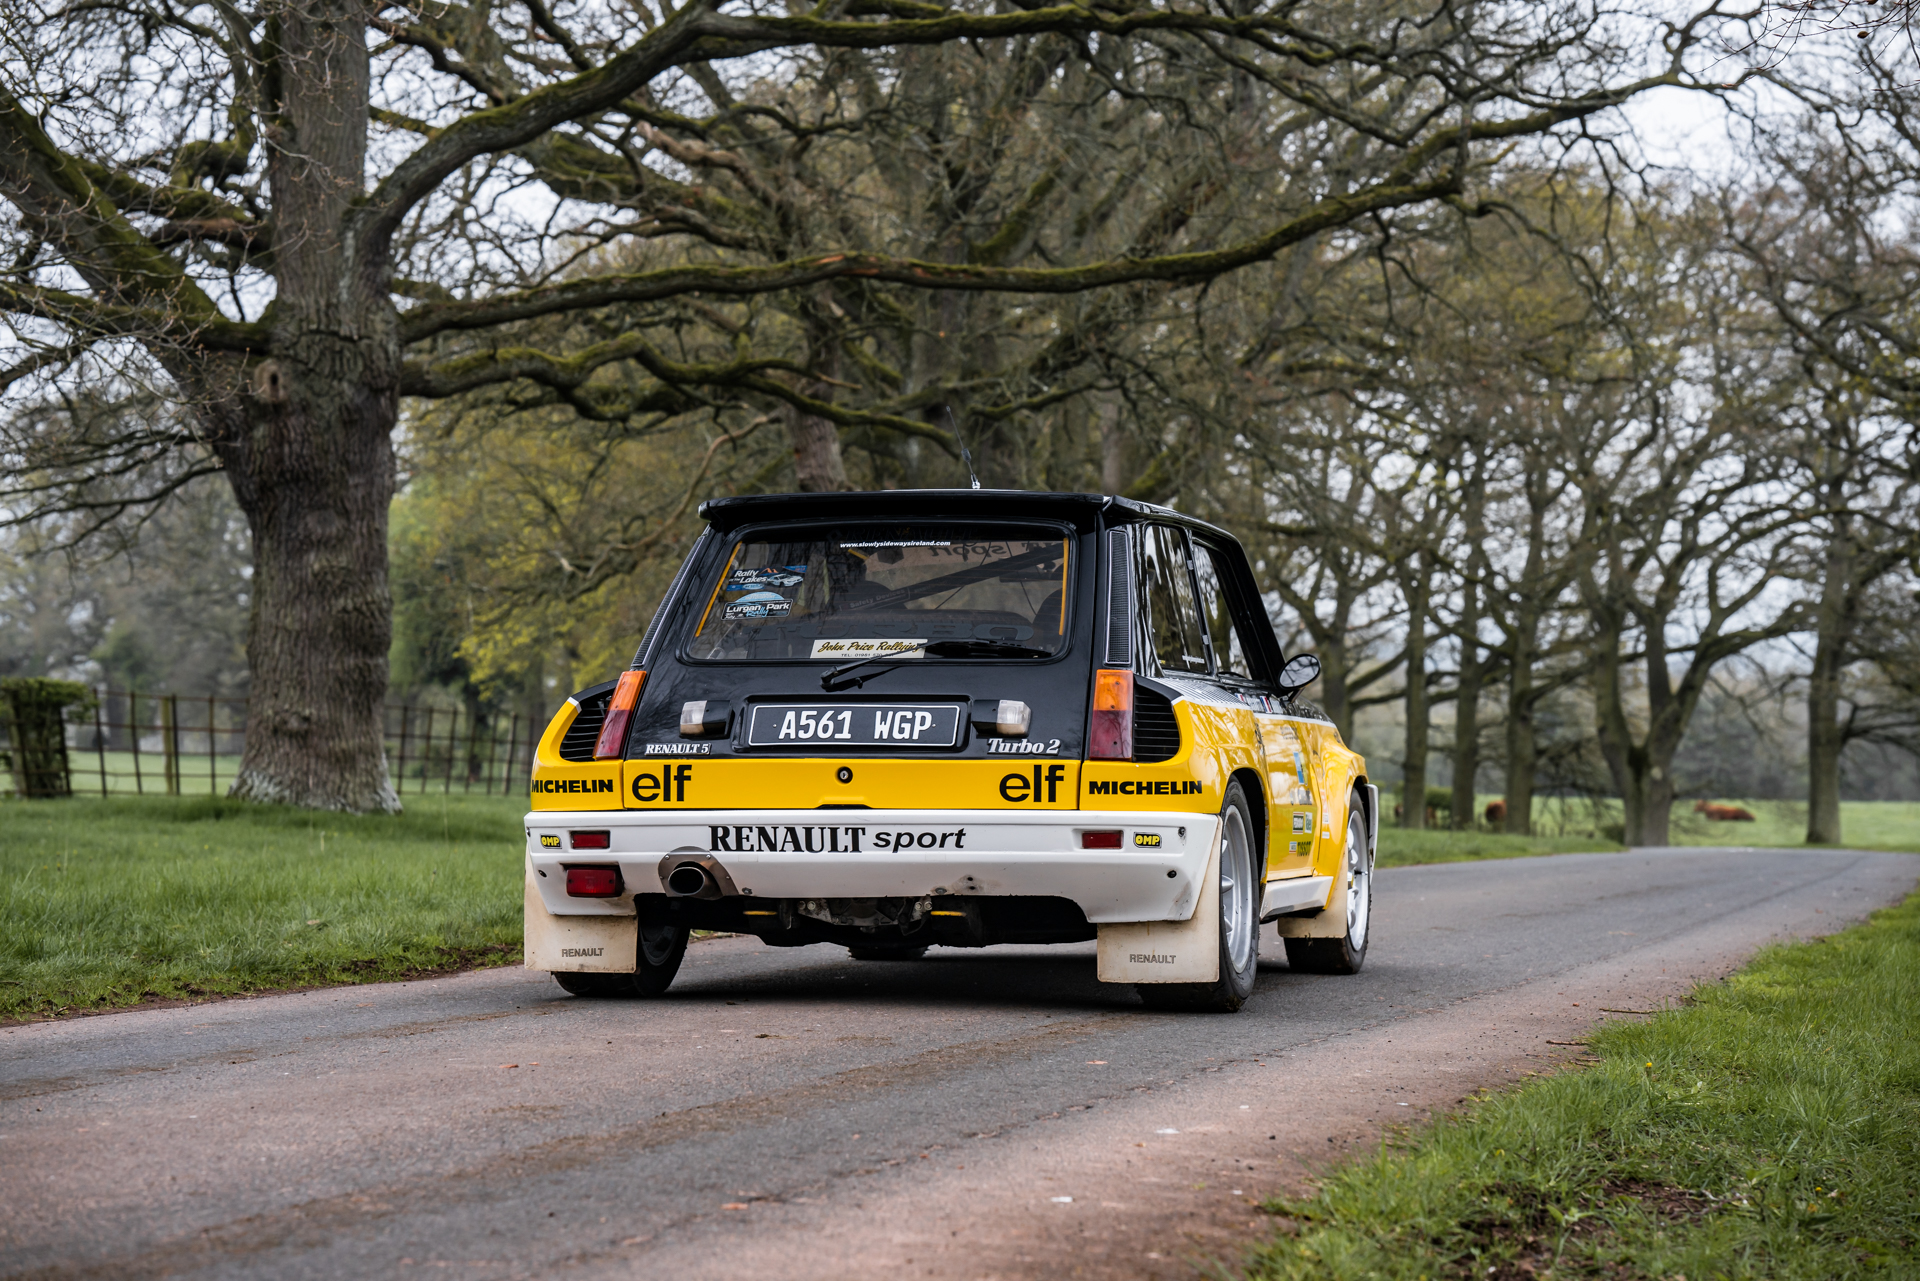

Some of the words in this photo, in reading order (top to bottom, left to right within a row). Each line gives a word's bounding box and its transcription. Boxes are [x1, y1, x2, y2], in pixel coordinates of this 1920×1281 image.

[840, 540, 950, 548] www.slowlysidewaysireland.com
[734, 569, 759, 578] Rally
[739, 576, 768, 584] Lakes
[727, 604, 761, 613] Lurgan
[745, 606, 769, 618] Rally
[817, 641, 845, 653] John
[847, 641, 874, 651] Price
[876, 641, 920, 653] Rallying
[778, 711, 852, 740] A561
[873, 711, 932, 740] WGP
[645, 744, 700, 754] RENAULT
[700, 743, 709, 754] 5
[988, 738, 1045, 754] Turbo
[1046, 738, 1061, 754] 2
[531, 779, 614, 793] MICHELIN
[632, 764, 693, 802] elf
[999, 765, 1065, 802] elf
[1089, 780, 1203, 795] MICHELIN
[541, 836, 560, 847] OMP
[708, 825, 866, 853] RENAULT
[872, 827, 967, 853] sport
[1135, 834, 1160, 846] OMP
[561, 947, 604, 957] RENAULT
[1129, 954, 1176, 964] RENAULT
